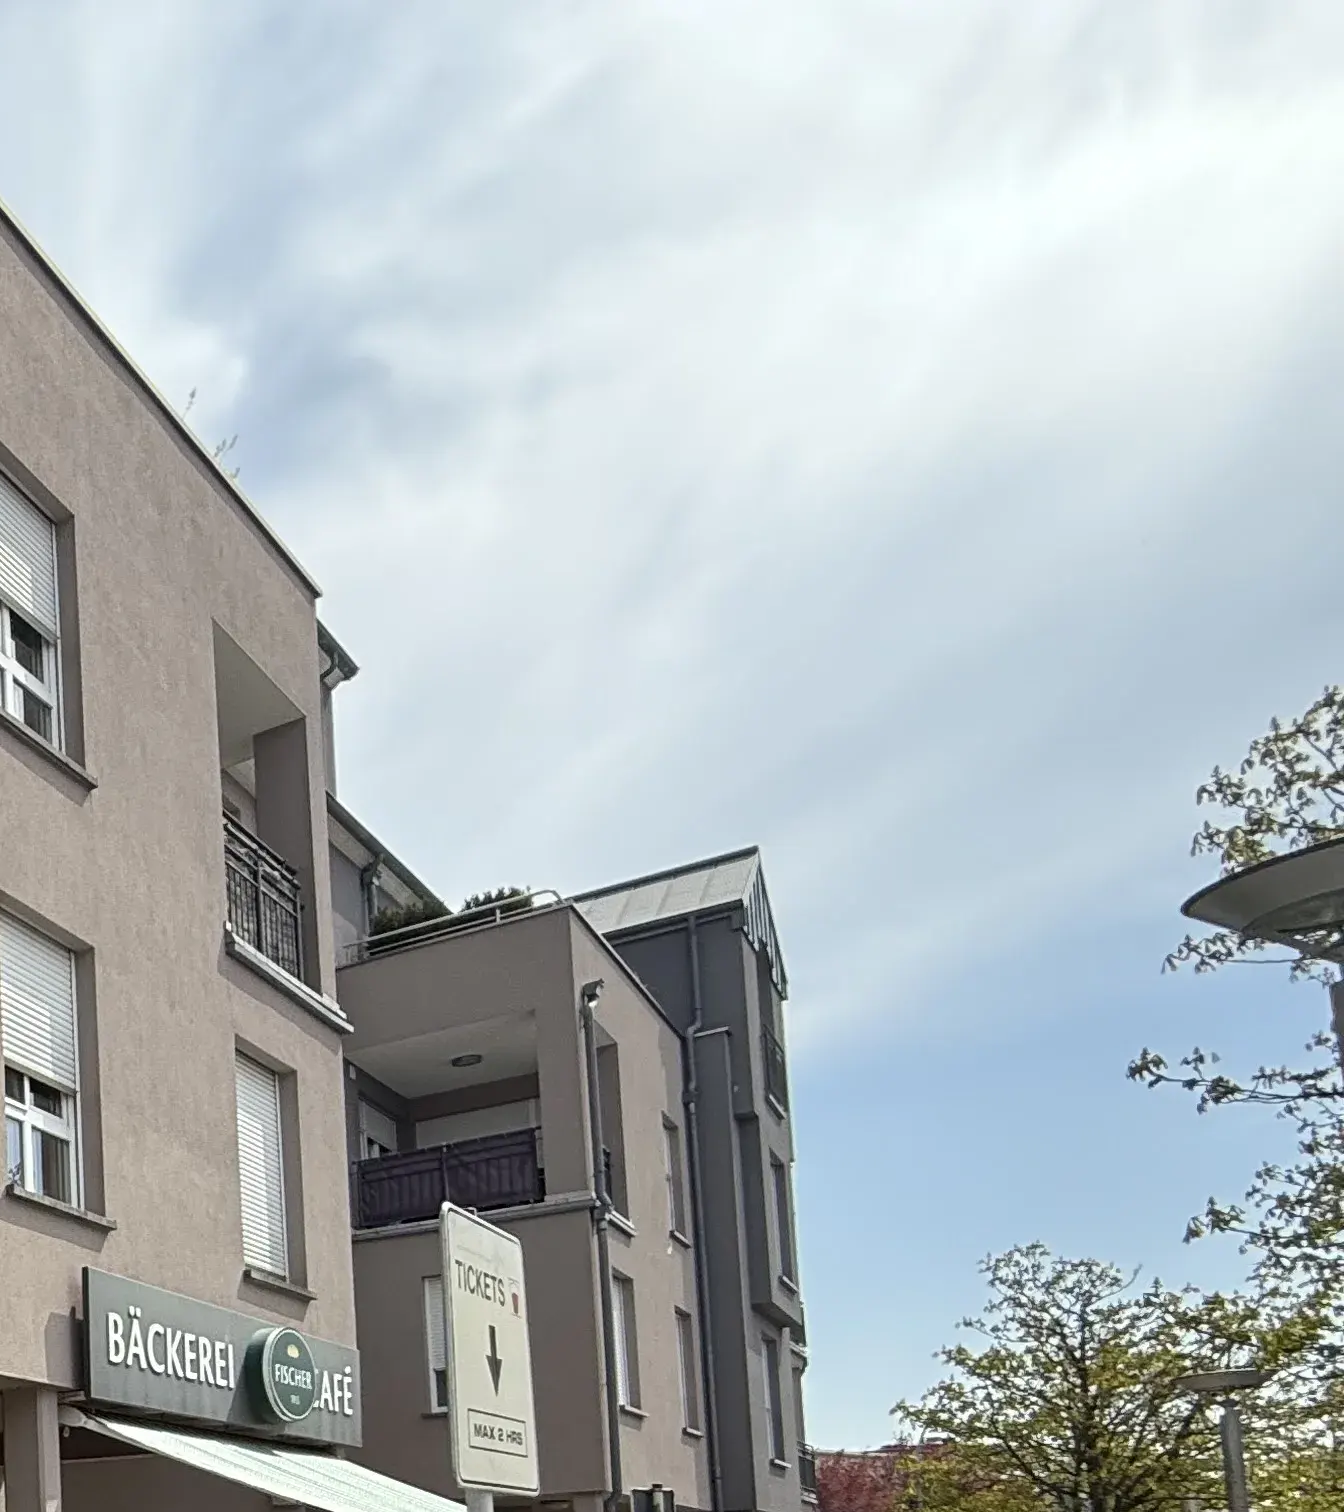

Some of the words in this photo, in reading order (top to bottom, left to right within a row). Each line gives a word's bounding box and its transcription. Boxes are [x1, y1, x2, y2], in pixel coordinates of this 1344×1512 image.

[455, 1259, 506, 1307] TICKETS
[107, 1305, 235, 1389] BÄCKEREI
[275, 1363, 313, 1390] FISCHER
[313, 1366, 354, 1415] AFÉ
[473, 1423, 496, 1440] MAX
[498, 1427, 504, 1442] 2
[506, 1430, 523, 1446] HRS
